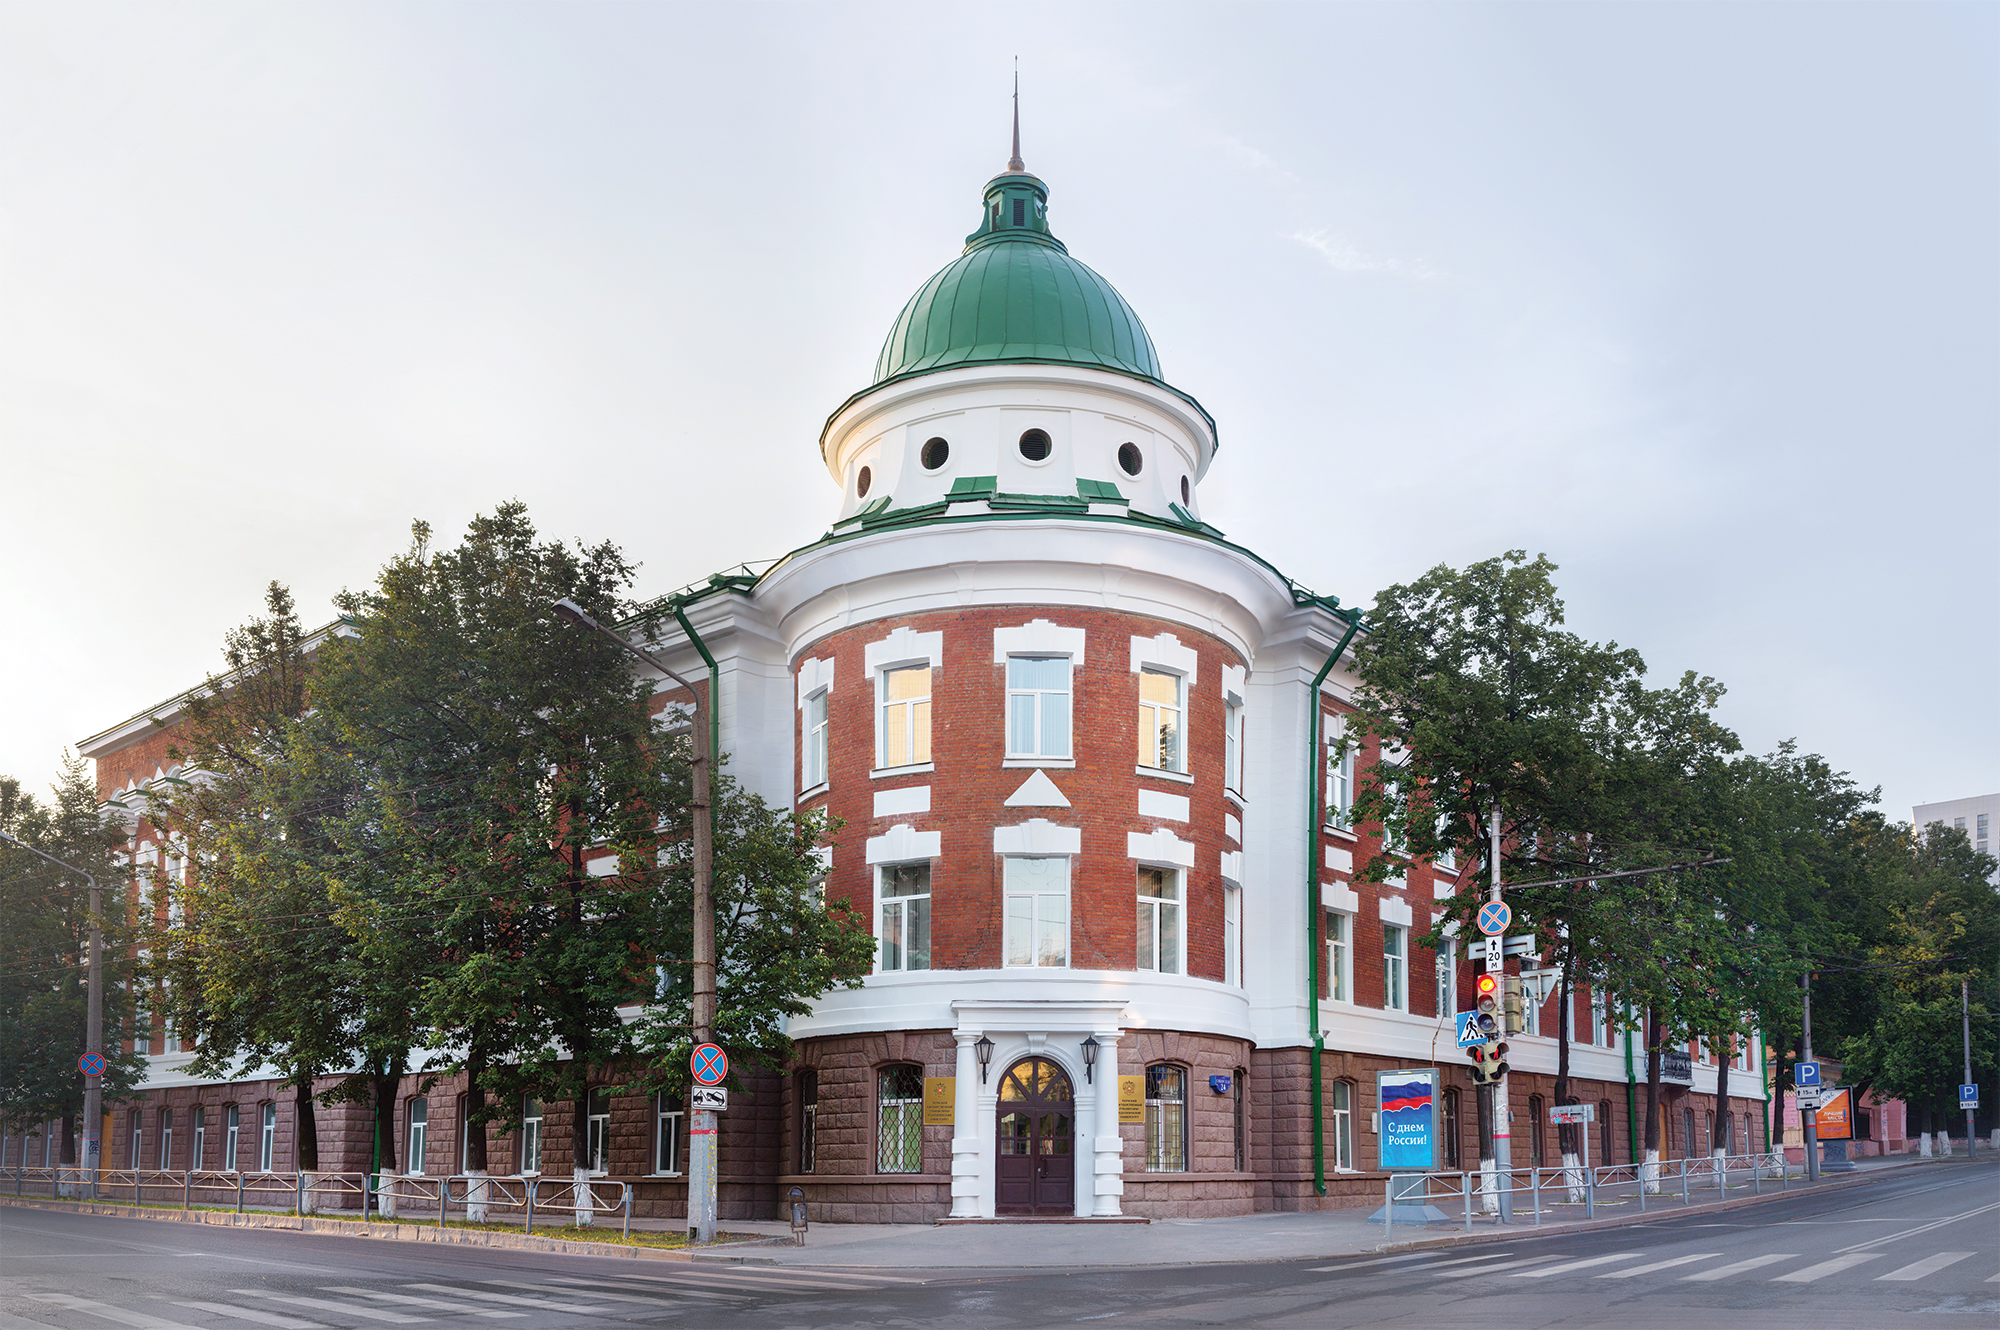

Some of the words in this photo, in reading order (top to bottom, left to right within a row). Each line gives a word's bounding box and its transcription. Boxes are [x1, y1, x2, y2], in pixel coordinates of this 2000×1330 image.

[1488, 952, 1500, 961] 20
[1802, 1065, 1815, 1083] P
[1964, 1086, 1974, 1099] P
[1388, 1122, 1396, 1132] С
[1397, 1124, 1424, 1134] днем
[1388, 1135, 1427, 1145] России!
